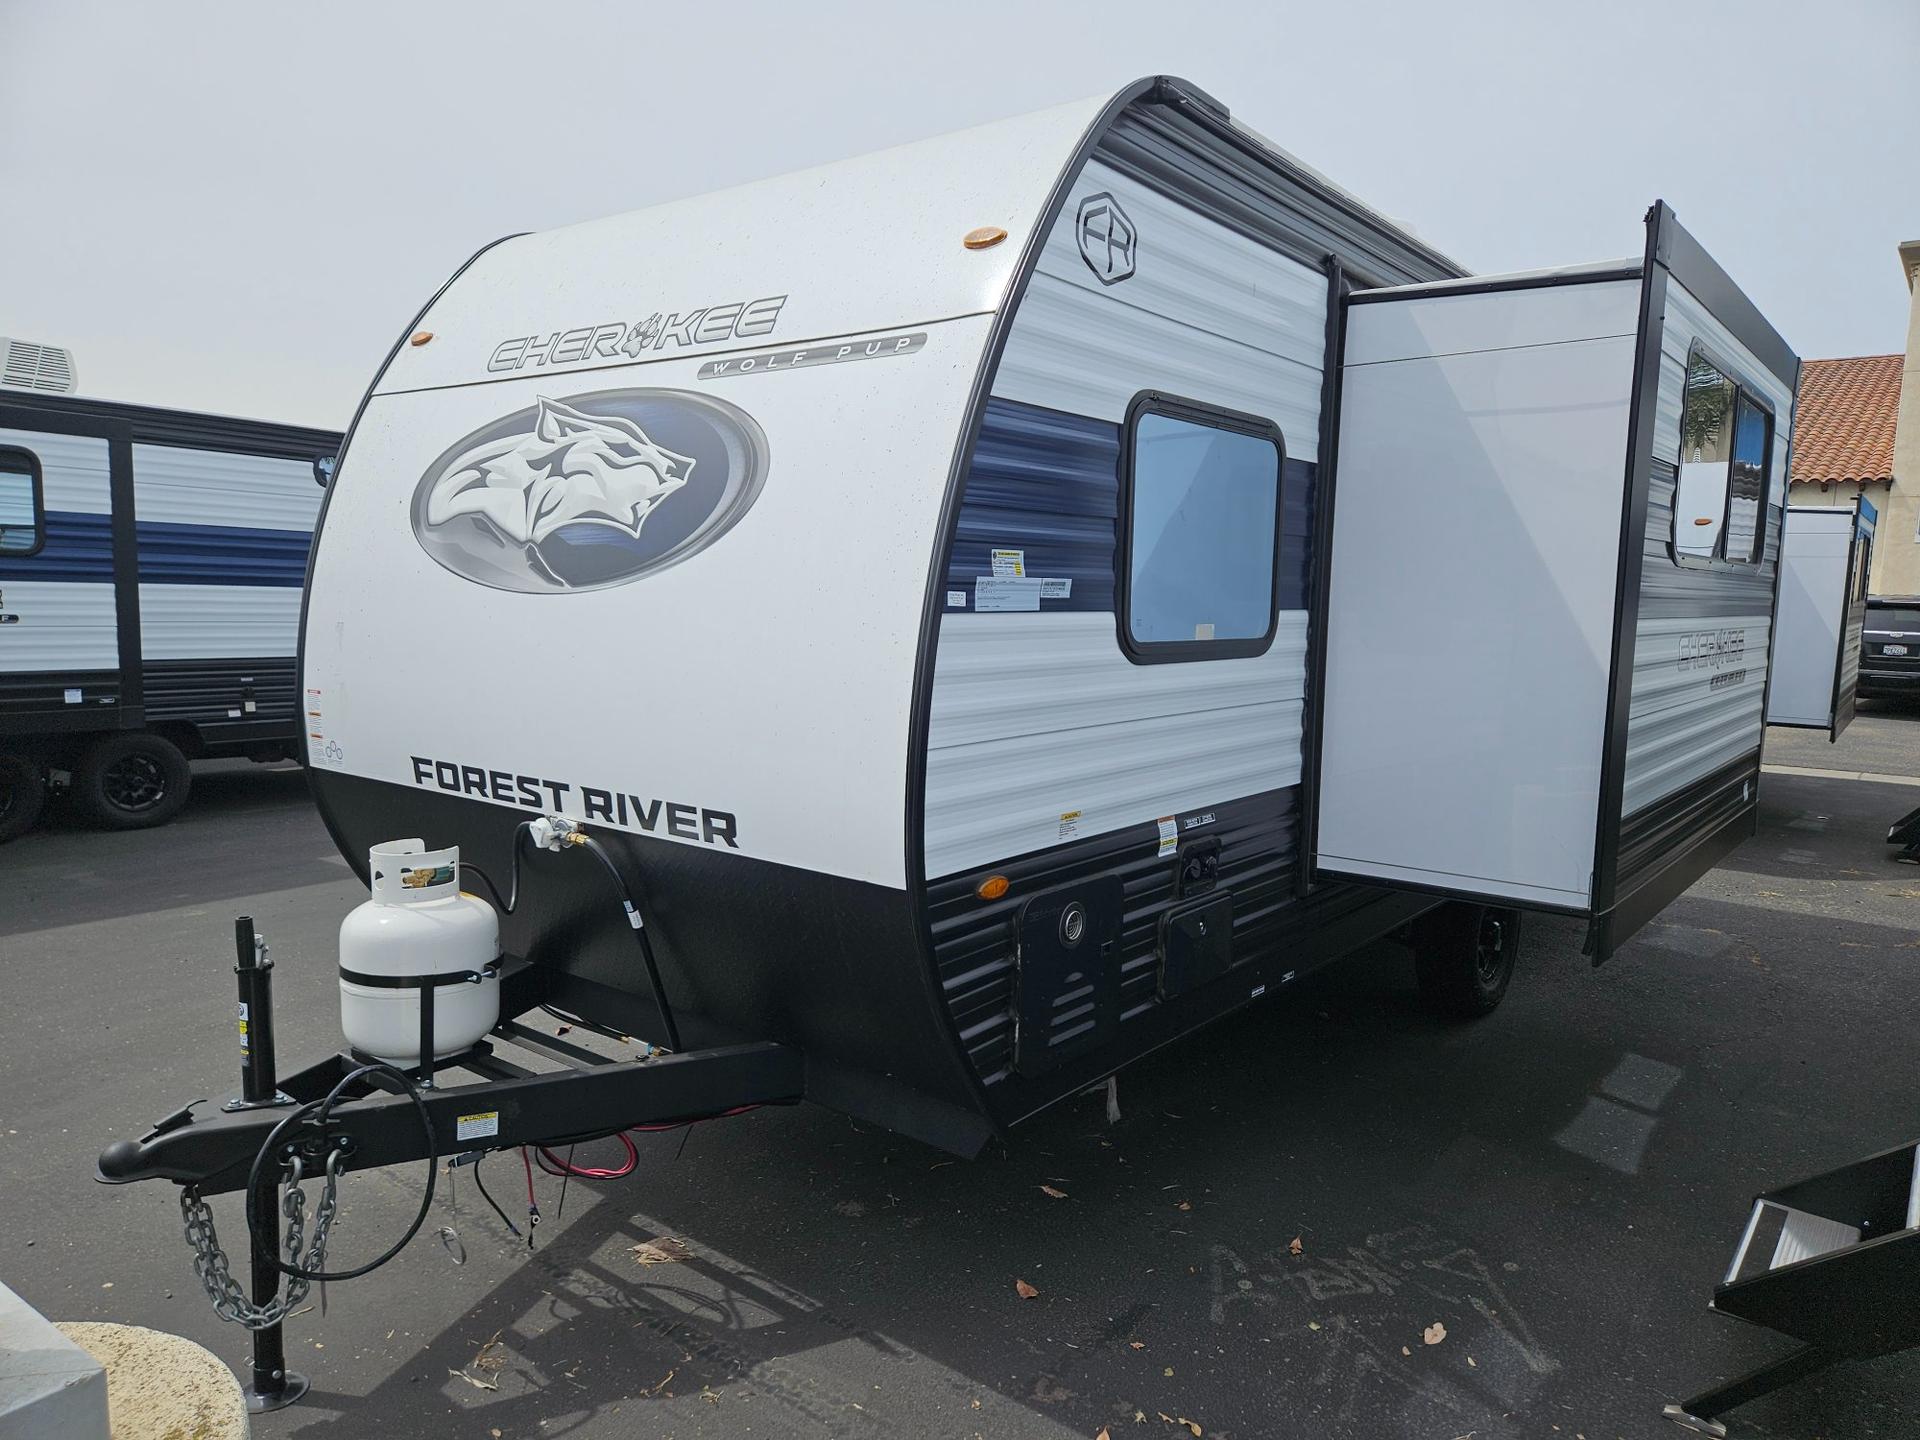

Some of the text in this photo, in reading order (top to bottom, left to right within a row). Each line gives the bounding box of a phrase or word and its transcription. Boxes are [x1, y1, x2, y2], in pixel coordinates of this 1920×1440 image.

[487, 294, 788, 373] CHEROKEE
[712, 337, 911, 376] WOLF PUP
[410, 755, 740, 849] FOREST RIVER
